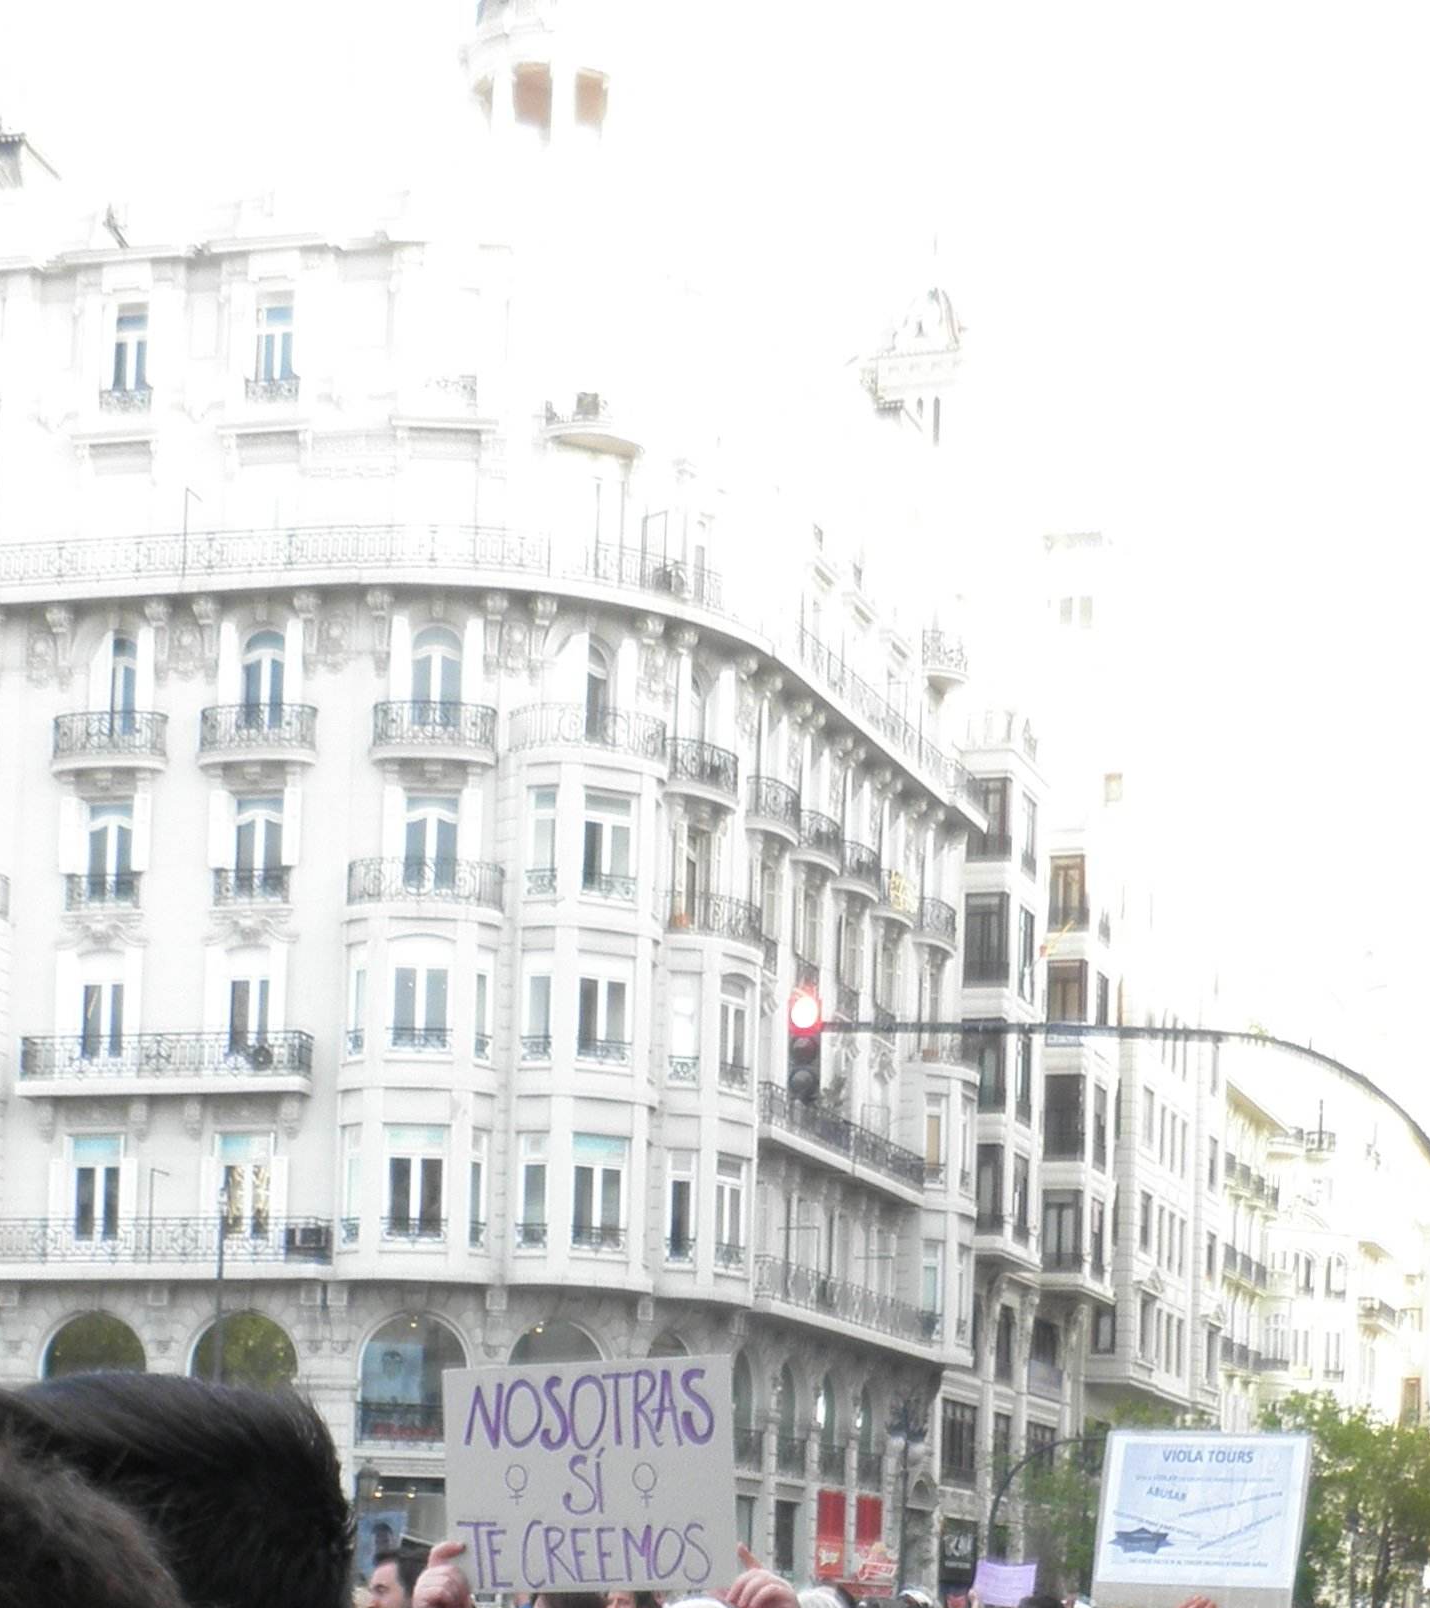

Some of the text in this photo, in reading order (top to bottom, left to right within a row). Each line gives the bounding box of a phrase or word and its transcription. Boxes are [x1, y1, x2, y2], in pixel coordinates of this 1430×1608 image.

[464, 1368, 715, 1451] NOSOTRAS
[562, 1447, 605, 1515] SÍ
[1162, 1449, 1255, 1464] VIOLA TOURS
[1146, 1486, 1188, 1502] ABUSAR
[456, 1519, 712, 1589] TE CREEMOS
